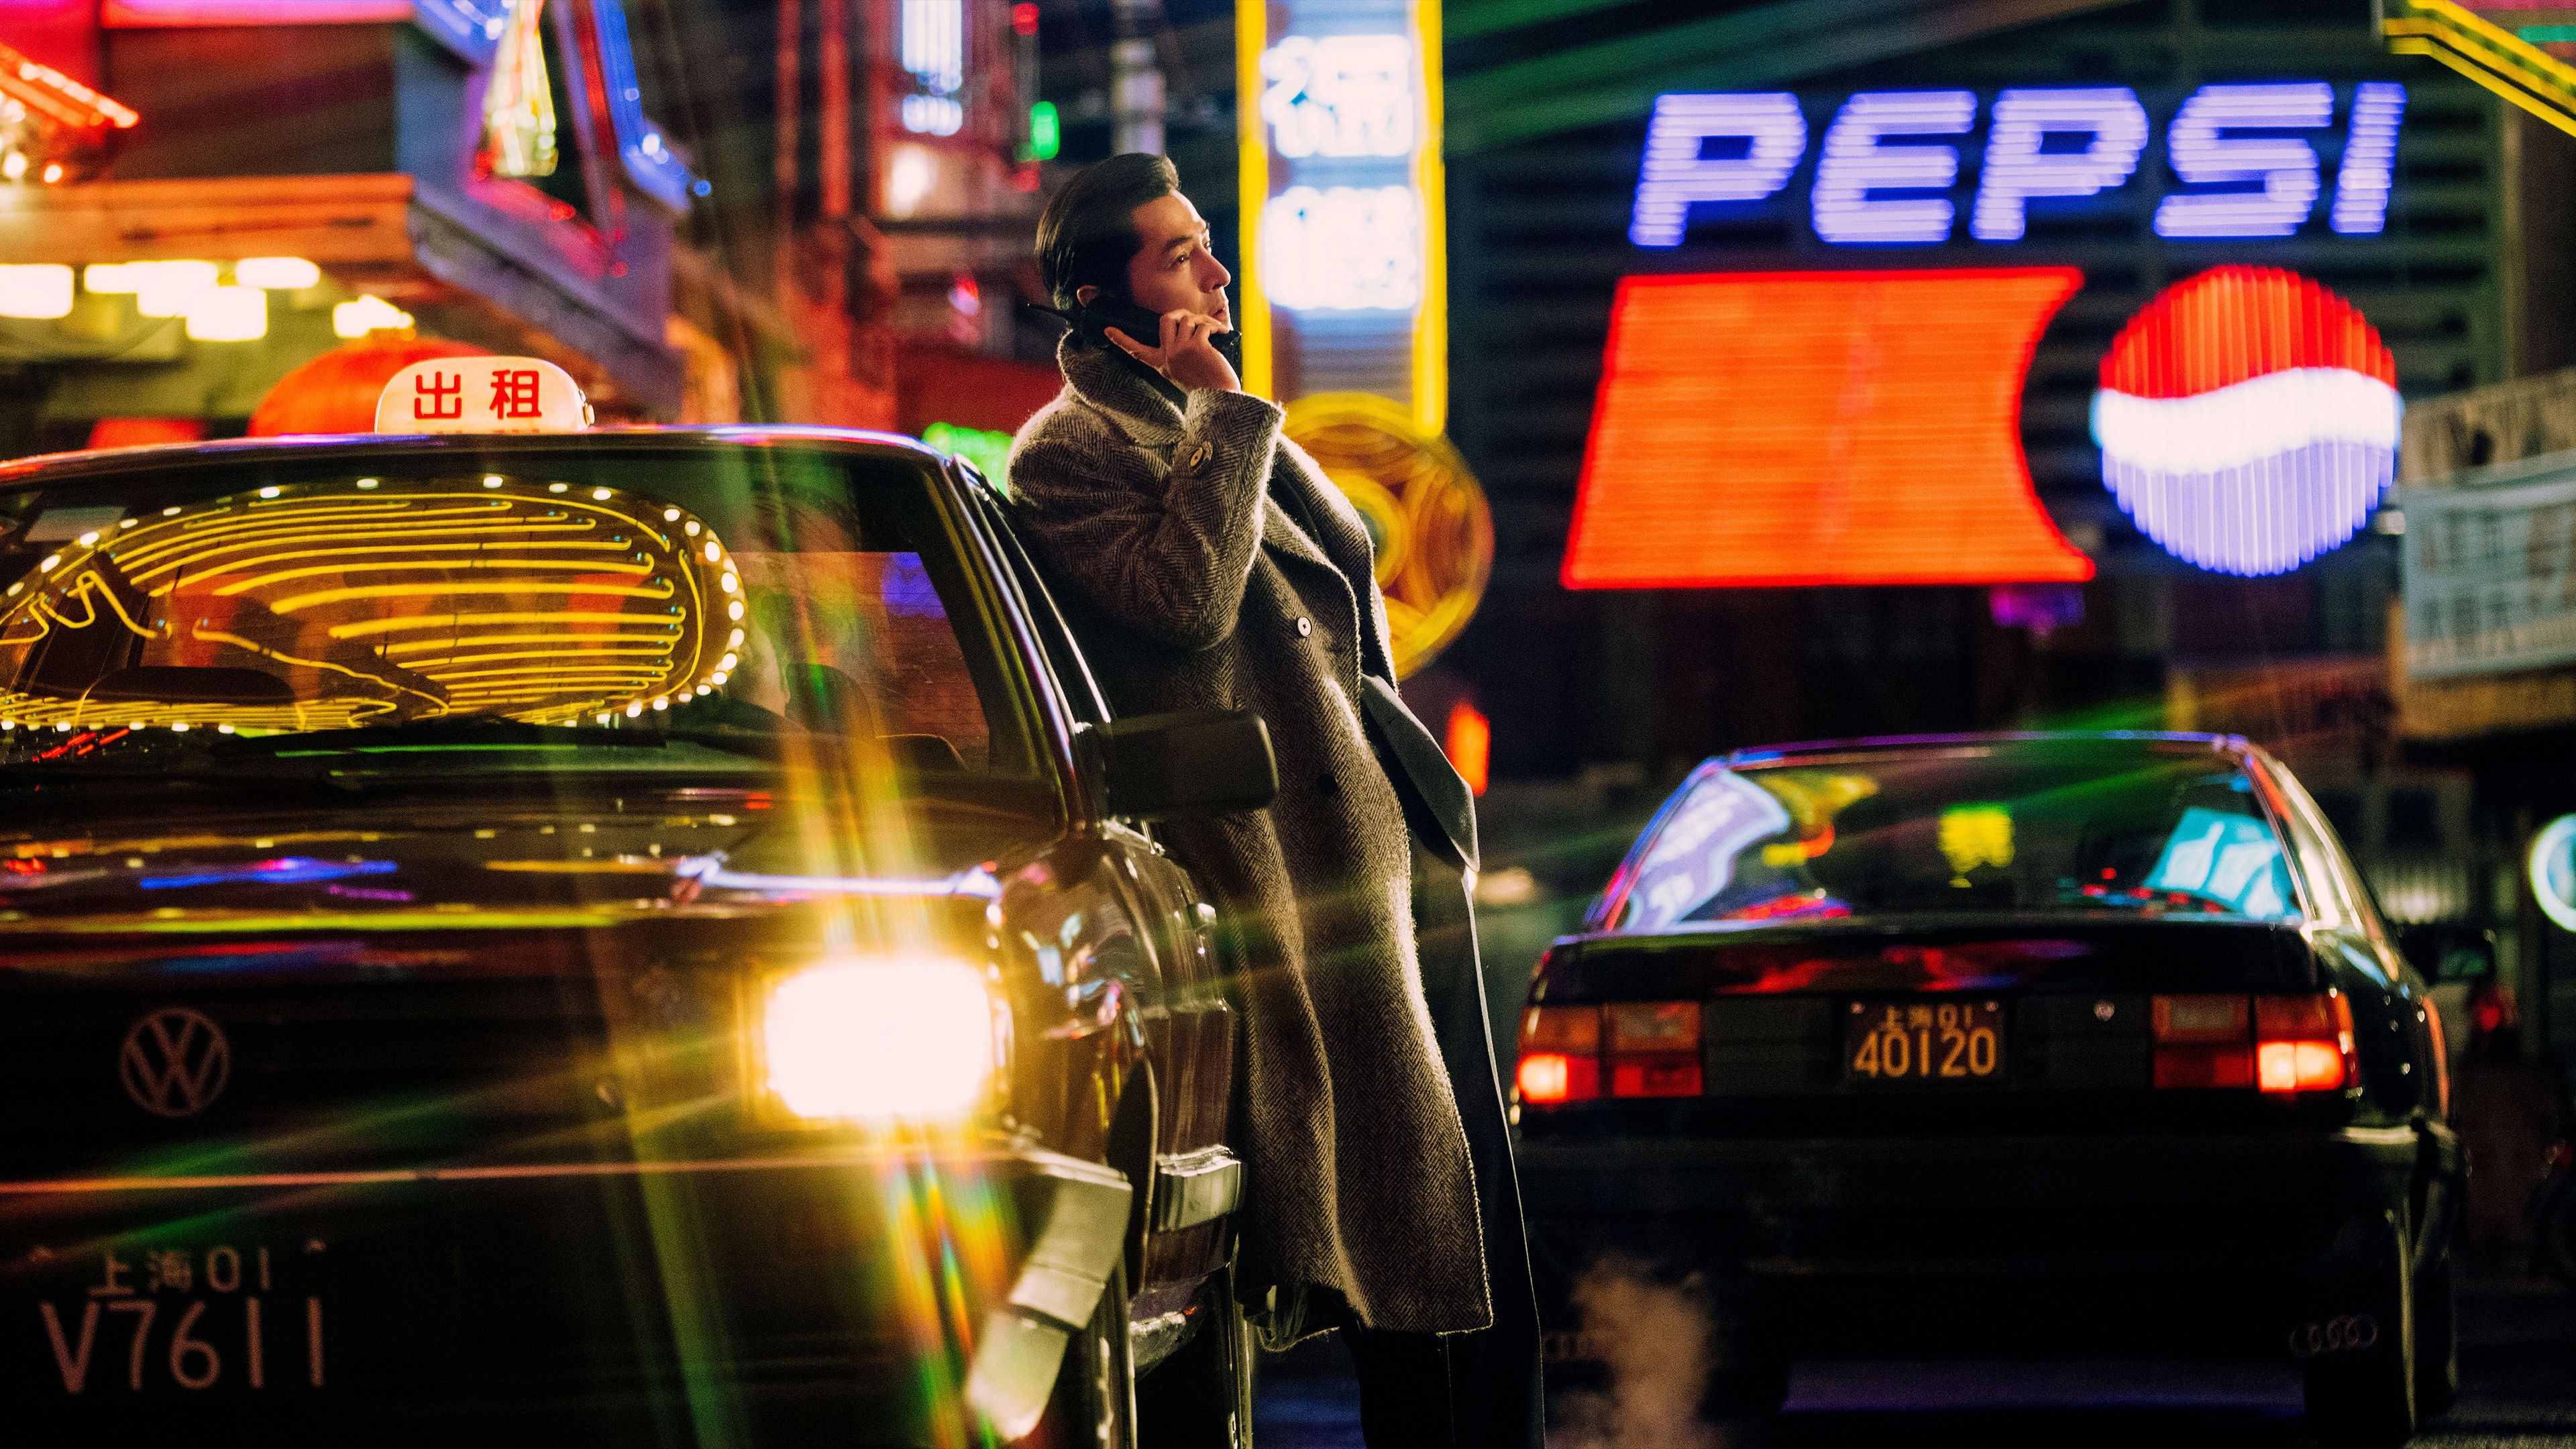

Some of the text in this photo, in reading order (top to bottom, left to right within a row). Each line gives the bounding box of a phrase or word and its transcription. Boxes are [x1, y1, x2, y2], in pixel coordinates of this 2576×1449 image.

[1629, 83, 2407, 248] PEPSI
[413, 369, 543, 420] 出租
[1854, 1026, 1996, 1078] 40120
[87, 1245, 272, 1297] 上海01
[38, 1296, 325, 1395] V7611
